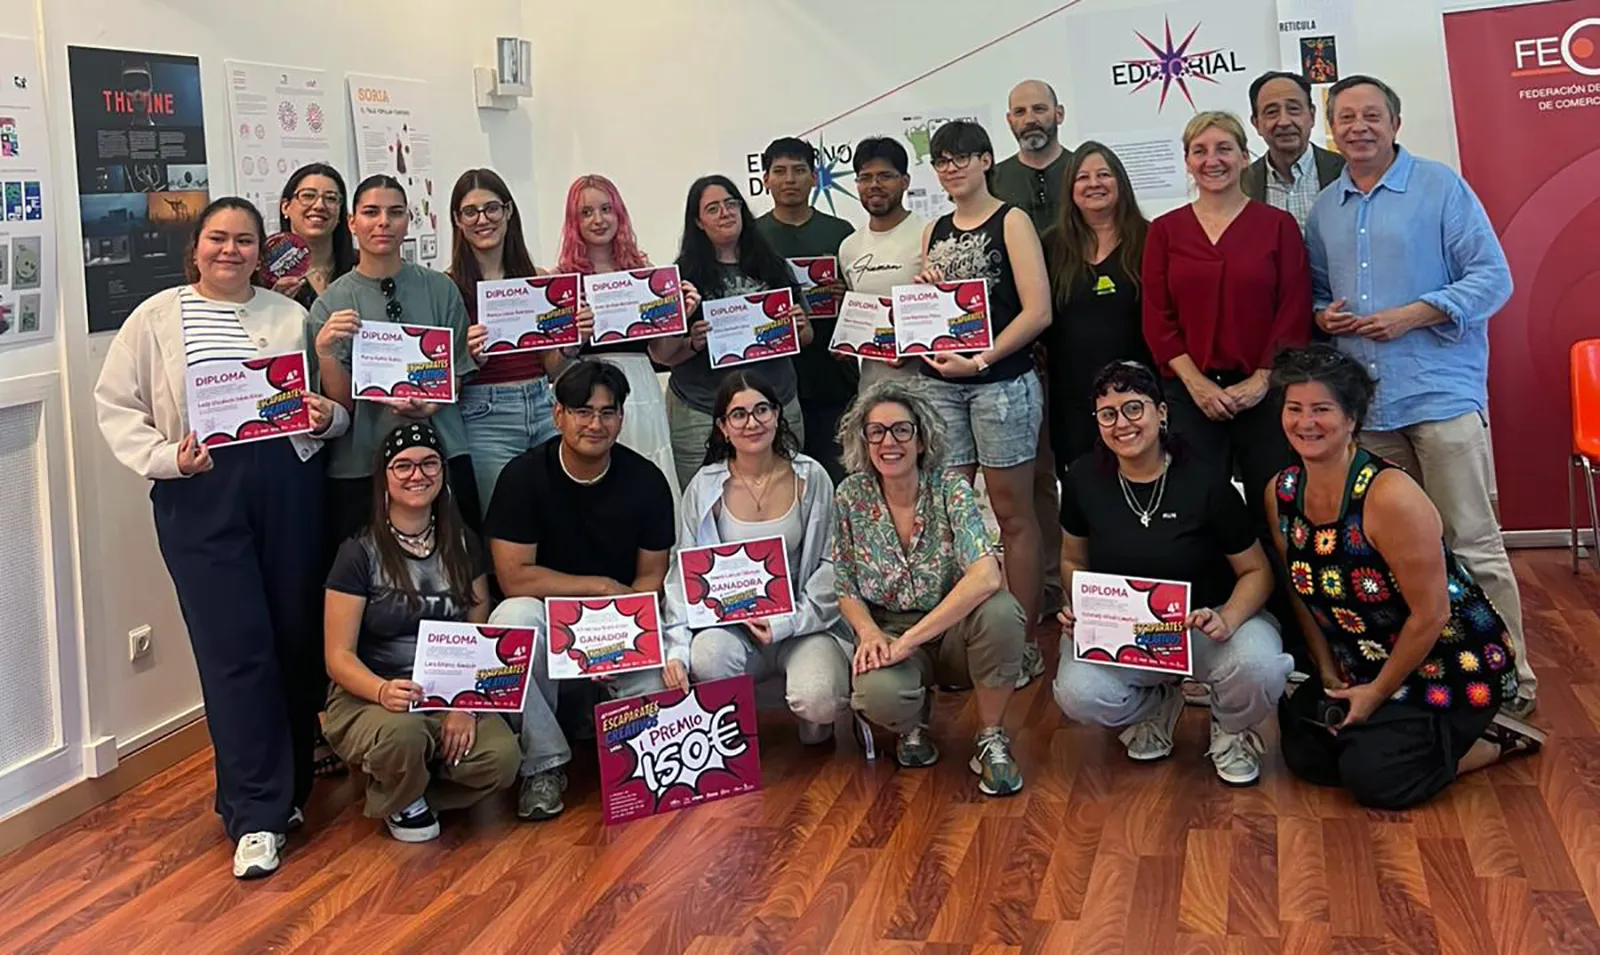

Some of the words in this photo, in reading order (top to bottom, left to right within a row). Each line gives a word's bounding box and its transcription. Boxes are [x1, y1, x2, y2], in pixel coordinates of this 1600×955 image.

[1519, 84, 1586, 99] FEDERACIÓN
[1587, 83, 1600, 93] DE
[1538, 101, 1553, 111] DE
[747, 144, 853, 173] ERNO
[592, 280, 633, 292] DIPLOMA
[486, 287, 529, 299] DIPLOMA
[899, 292, 939, 303] DIPLOMA
[710, 304, 748, 317] DIPLOMA
[848, 300, 878, 310] DIPLOMA
[361, 330, 404, 342] DIPLOMA
[195, 371, 246, 387] DIPLOMA
[710, 577, 763, 592] GANADORA
[1081, 584, 1129, 598] DIPLOMA
[427, 633, 478, 645] DIPLOMA
[579, 631, 628, 644] GANADOR
[602, 700, 660, 732] ESCAPARATES
[605, 715, 659, 744] CREATIVOS
[650, 714, 703, 746] PREMIO
